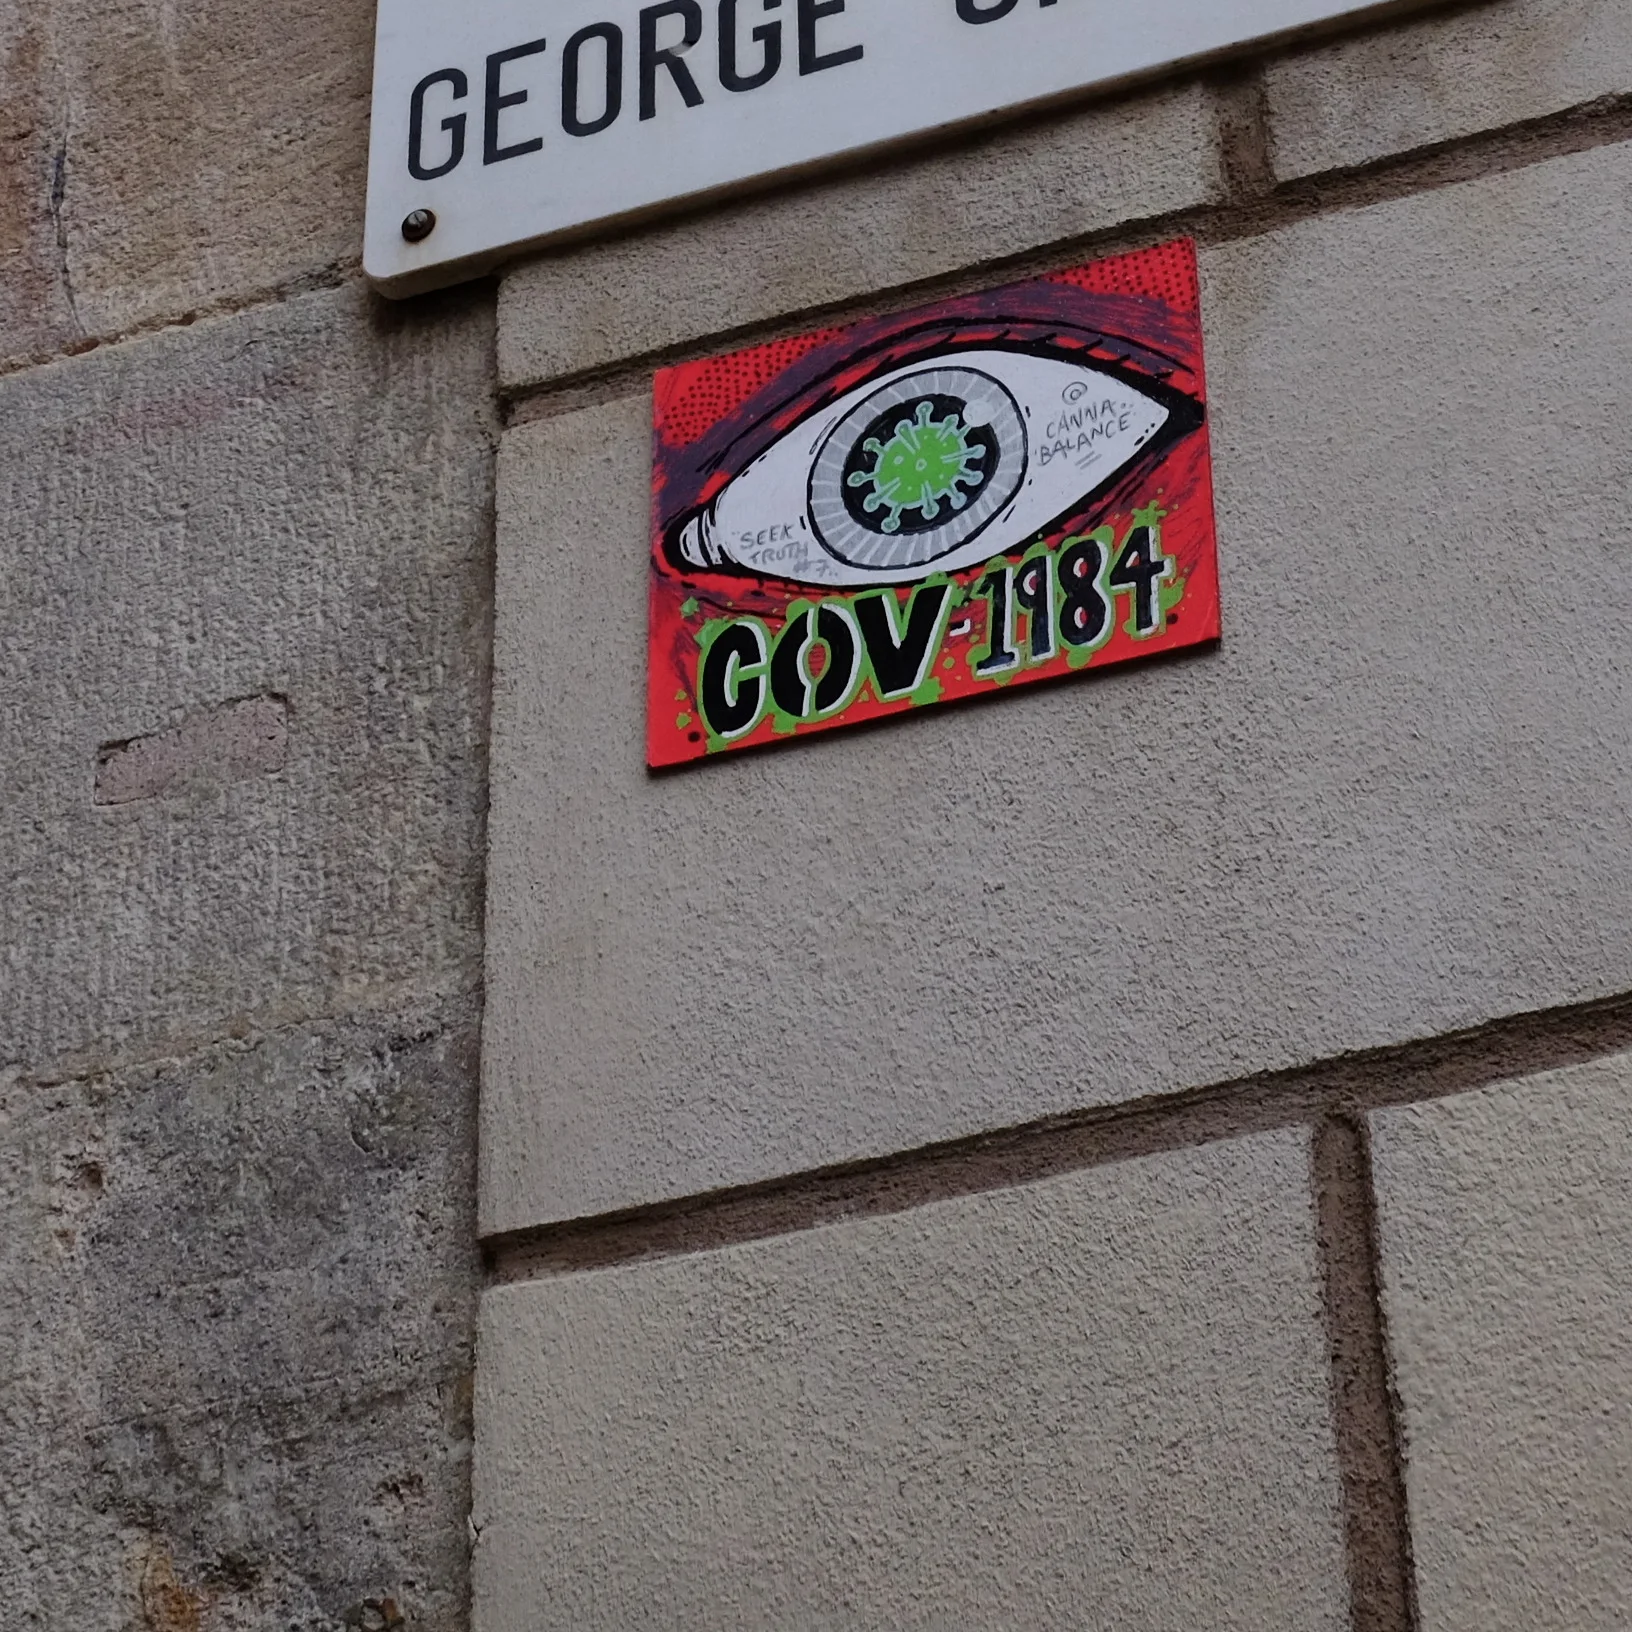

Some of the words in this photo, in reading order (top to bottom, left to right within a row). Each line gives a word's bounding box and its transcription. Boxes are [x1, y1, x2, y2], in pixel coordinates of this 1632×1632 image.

[1037, 410, 1131, 466] BALANCE
[739, 522, 795, 550] SEEK
[749, 540, 809, 566] TRUTH
